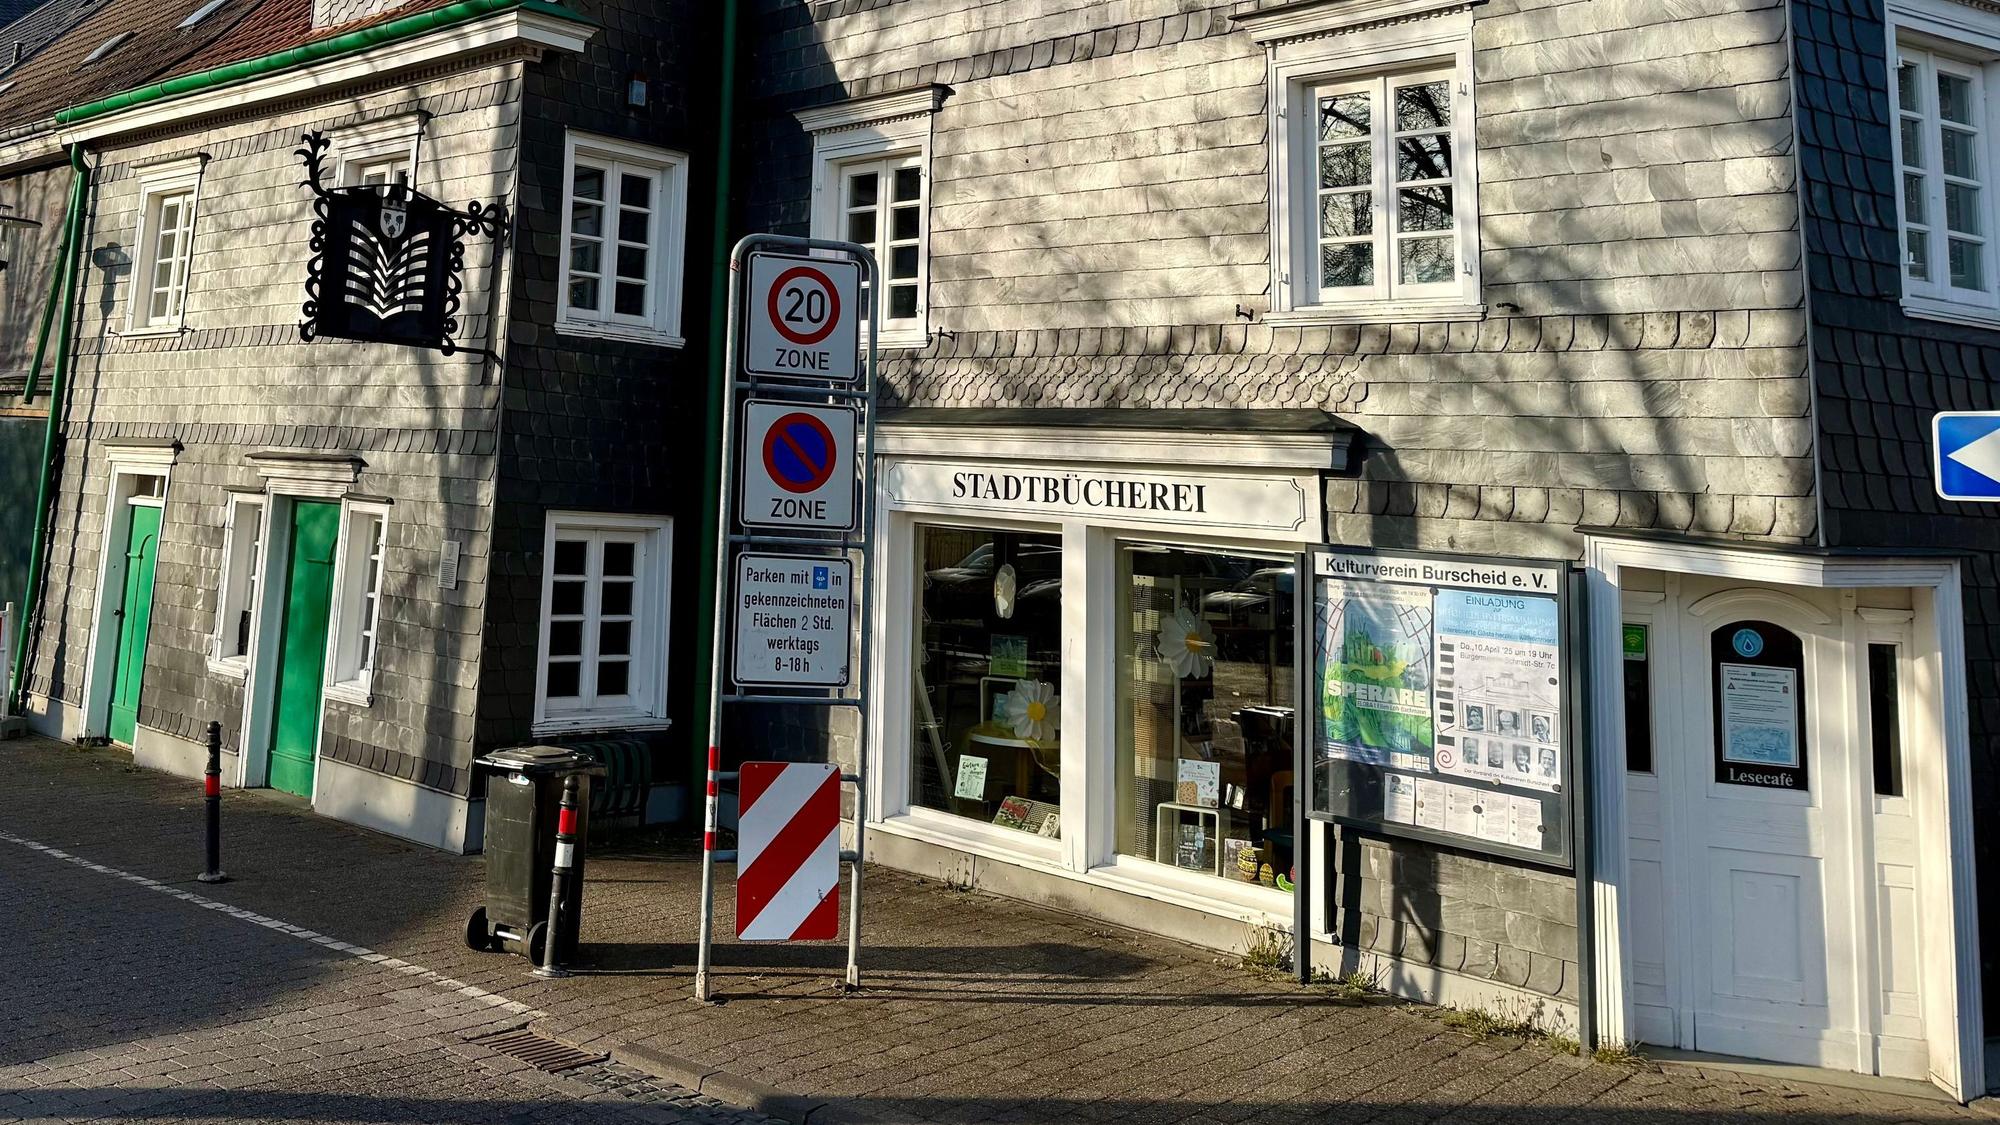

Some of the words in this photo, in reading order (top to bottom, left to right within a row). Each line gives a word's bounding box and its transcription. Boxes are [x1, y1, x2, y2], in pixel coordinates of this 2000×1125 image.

[785, 287, 826, 324] 20
[775, 348, 830, 371] ZONE
[953, 472, 1207, 513] STADTBÜCHEREI
[771, 498, 827, 520] ZONE
[746, 567, 785, 584] Parken
[790, 569, 809, 585] mit
[832, 572, 842, 586] in
[1325, 557, 1417, 579] Kulturverein
[1423, 565, 1507, 585] Burscheid
[1512, 575, 1527, 587] e.
[1531, 573, 1548, 589] V.
[744, 591, 845, 609] gekennzeichneten
[1466, 595, 1525, 609] EINLADUNG
[752, 612, 797, 629] Flächen
[801, 615, 808, 631] 2
[812, 615, 834, 631] Std.
[767, 635, 819, 654] werktags
[1538, 651, 1553, 660] Uhr
[1328, 679, 1427, 708] SPERARE
[1729, 767, 1793, 787] Lesecafé
